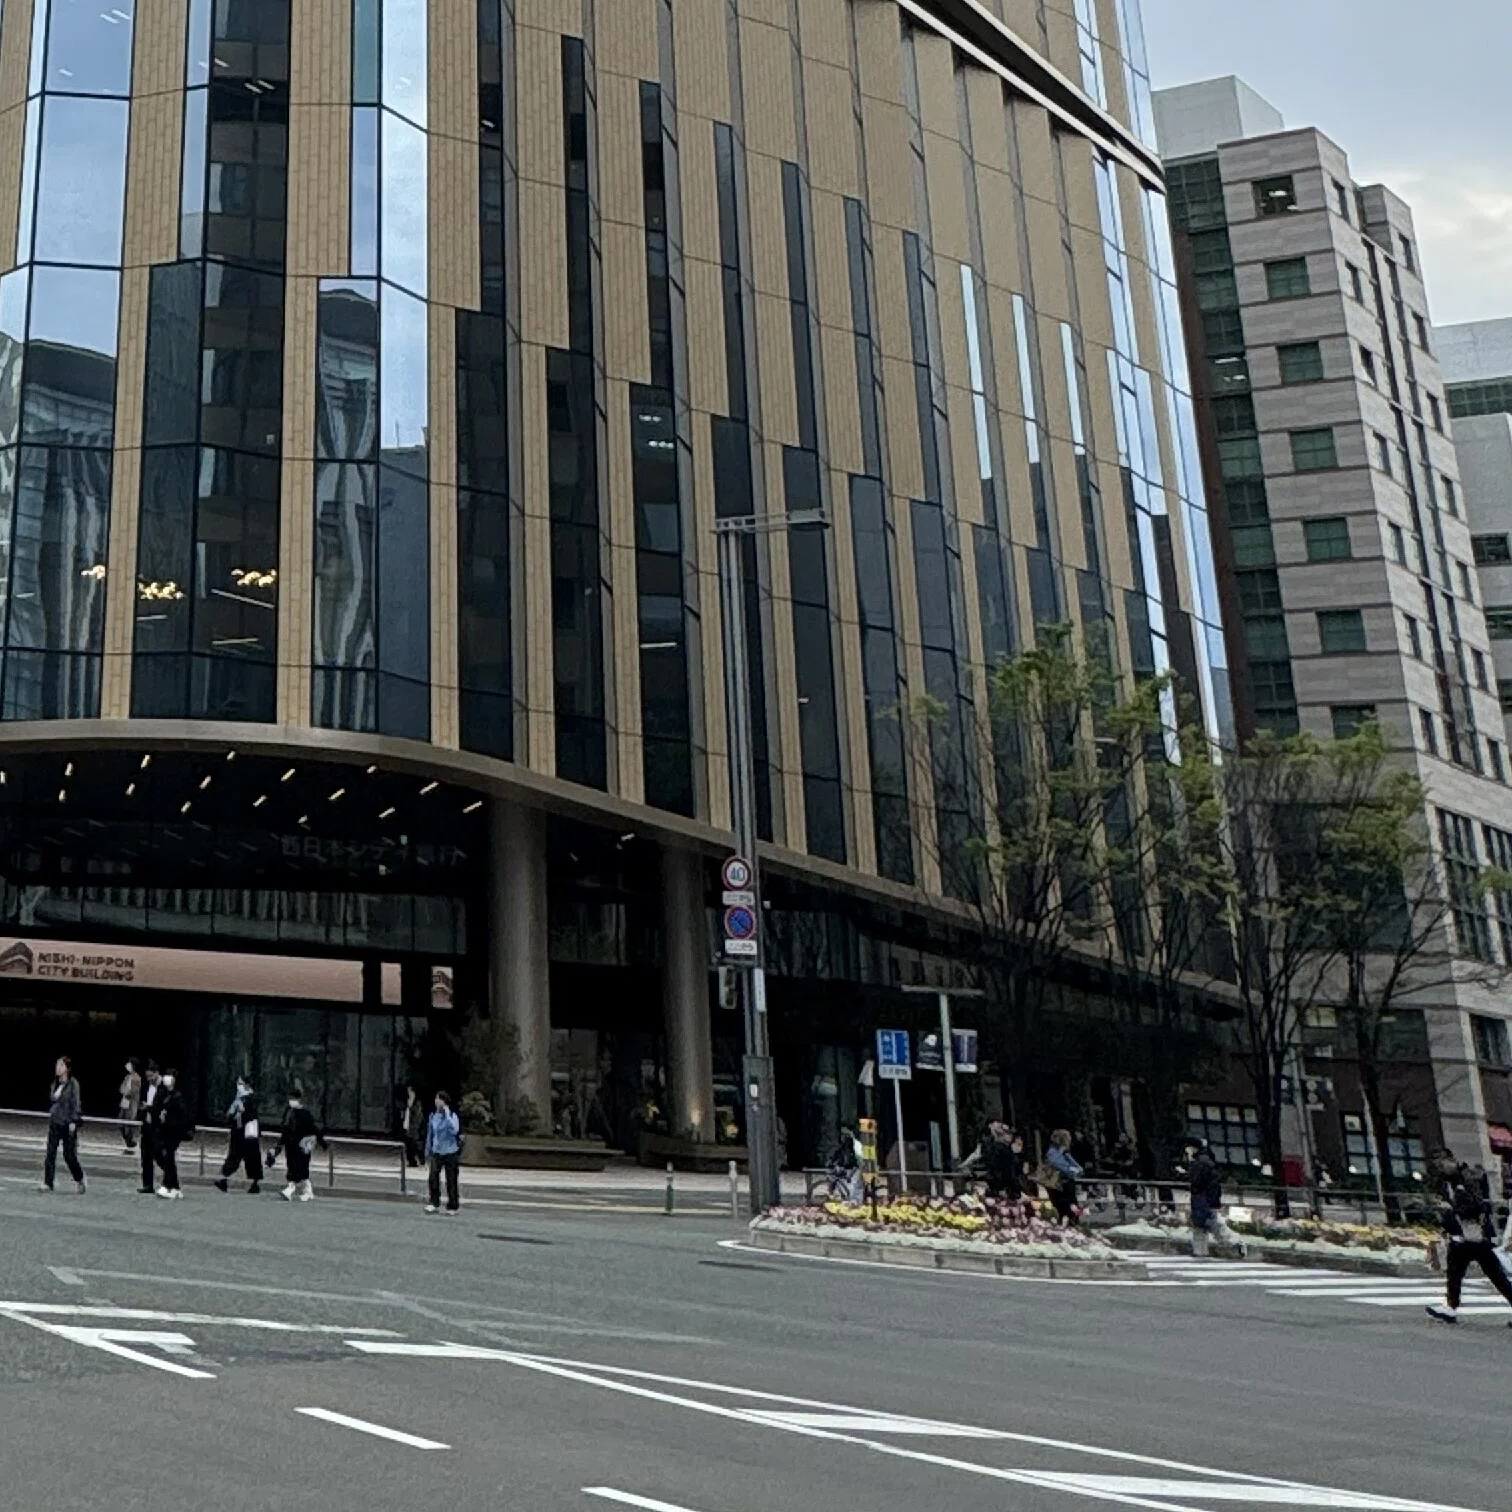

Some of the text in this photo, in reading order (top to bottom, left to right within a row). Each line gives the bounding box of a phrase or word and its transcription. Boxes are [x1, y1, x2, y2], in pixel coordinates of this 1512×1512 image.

[730, 867, 746, 882] 40
[38, 952, 134, 968] NISHI-NIPPON
[38, 965, 134, 982] CITY BUILDING
